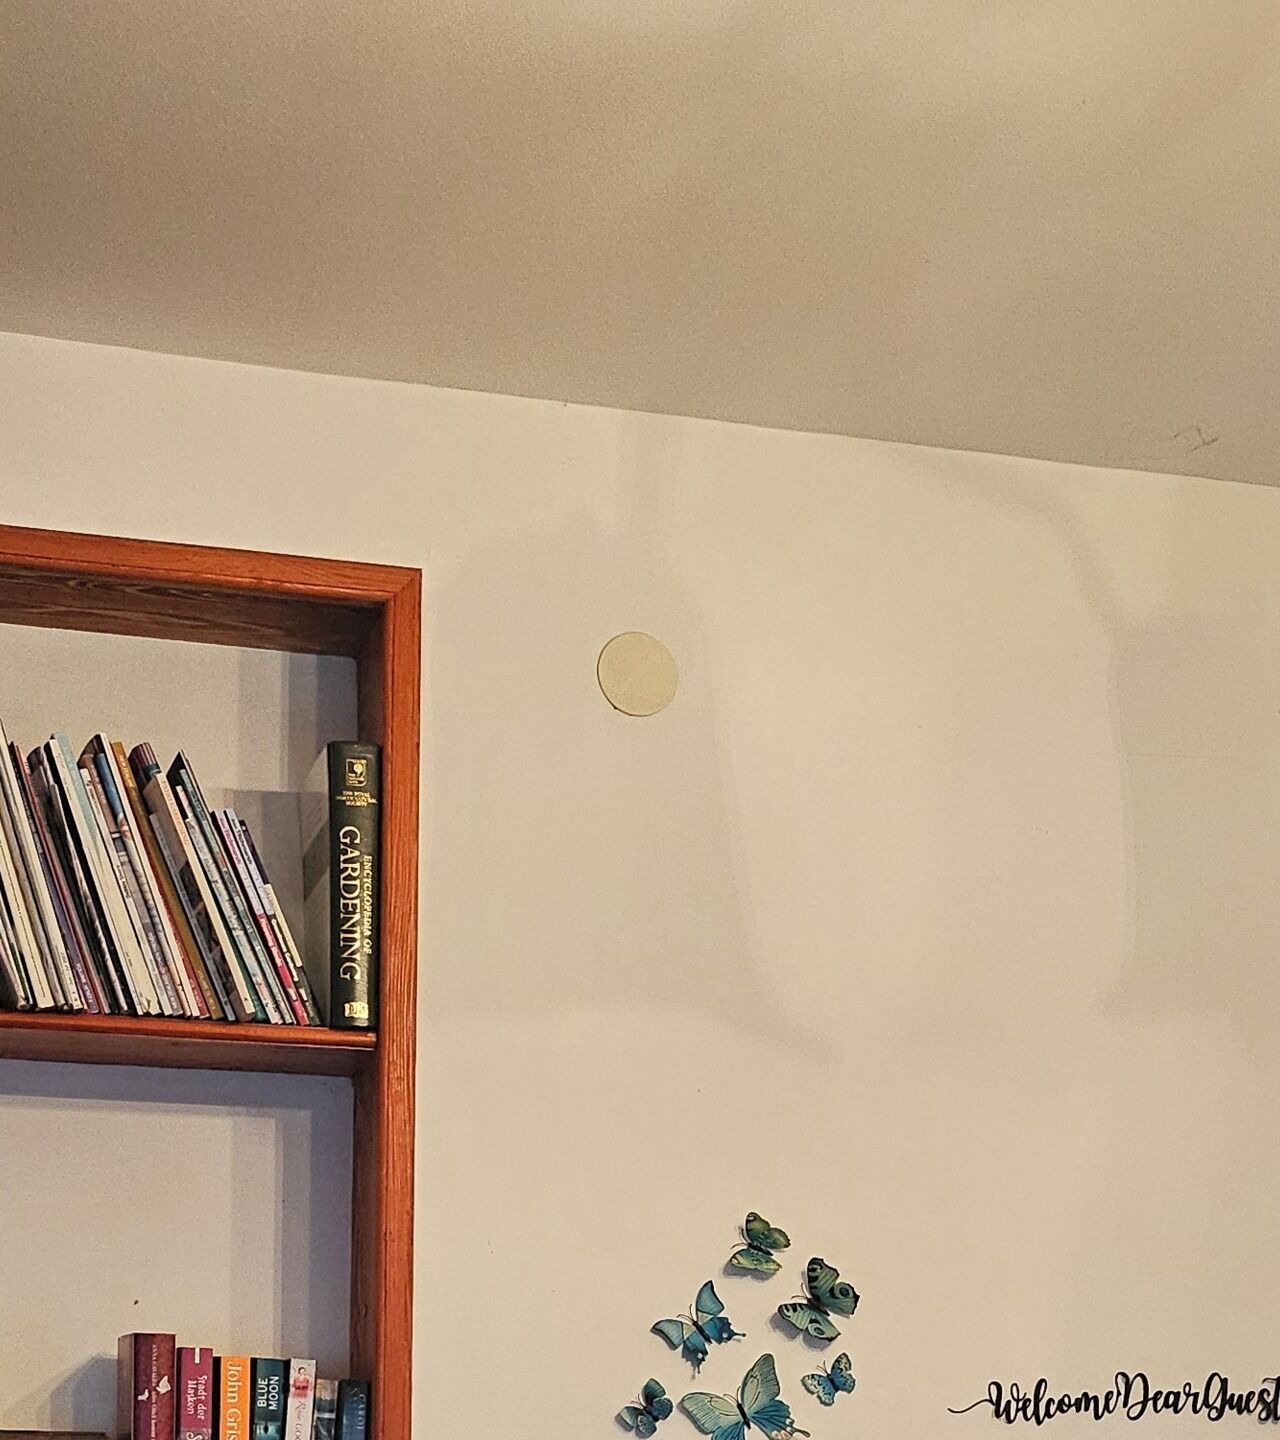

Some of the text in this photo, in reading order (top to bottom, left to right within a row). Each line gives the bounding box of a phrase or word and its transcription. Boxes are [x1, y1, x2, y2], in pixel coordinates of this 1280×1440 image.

[340, 826, 361, 980] GARDENING
[196, 1375, 207, 1420] Stadt der
[226, 1362, 243, 1401] John
[258, 1377, 267, 1407] BLUE
[269, 1376, 279, 1410] MOON
